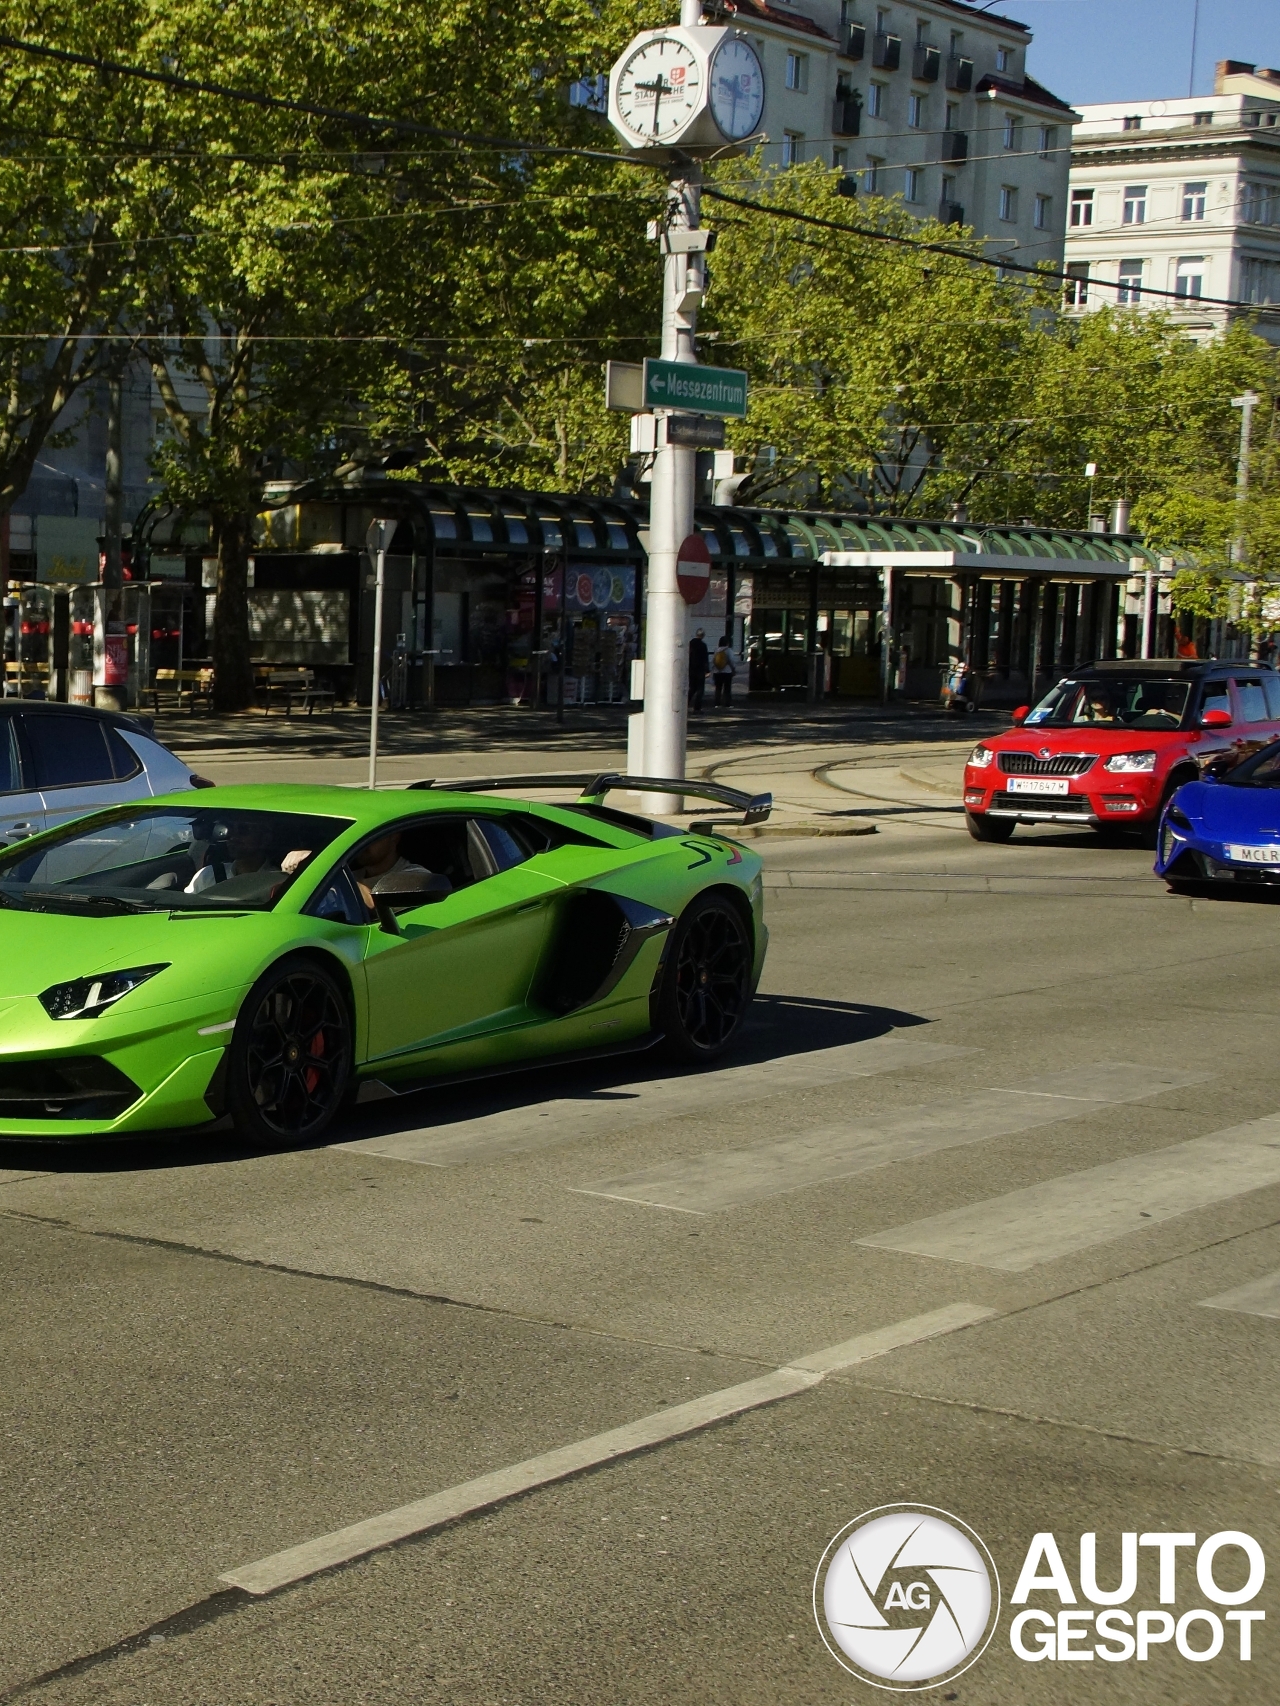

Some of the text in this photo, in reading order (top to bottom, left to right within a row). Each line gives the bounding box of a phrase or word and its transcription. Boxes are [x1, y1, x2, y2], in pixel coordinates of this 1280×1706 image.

[666, 371, 743, 404] Messezentrum
[525, 576, 555, 587] TAAK
[1029, 781, 1056, 791] 17647
[1241, 848, 1279, 862] MCLR
